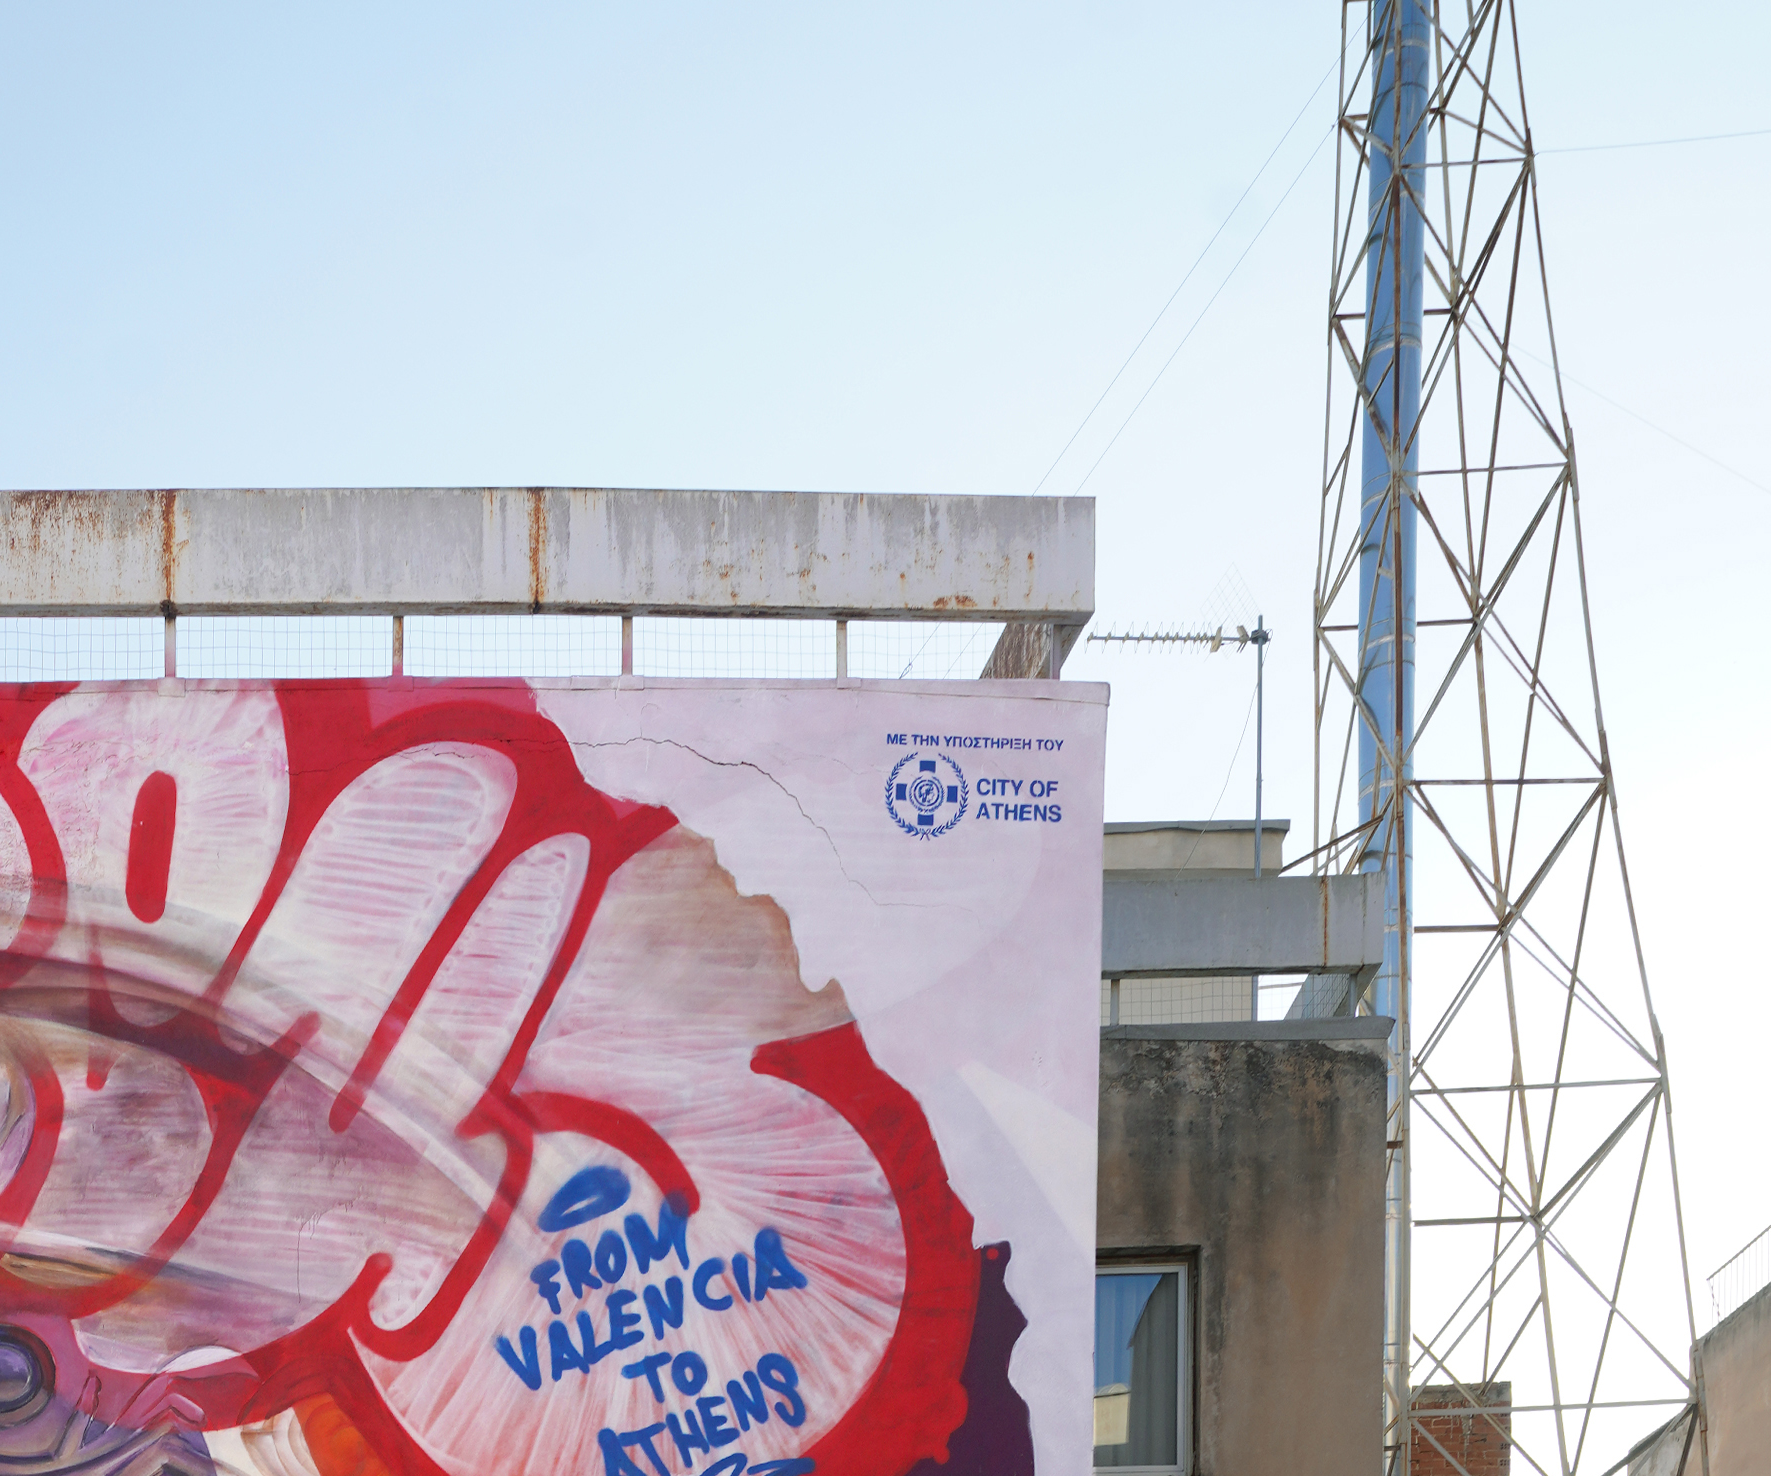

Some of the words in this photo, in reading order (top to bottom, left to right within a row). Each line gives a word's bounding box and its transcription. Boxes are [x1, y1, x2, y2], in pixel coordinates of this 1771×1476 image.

[886, 734, 908, 746] ΜΕ
[911, 734, 939, 747] ΤΗΝ
[943, 736, 1032, 751] ΥΠΟΣΤΗΡΙΞΗ
[1036, 739, 1064, 751] ΤΟΥ
[976, 778, 1024, 797] CITY
[1029, 780, 1059, 798] OF
[976, 802, 1062, 823] ATHENS
[530, 1193, 691, 1315] FROM
[494, 1226, 809, 1391] VALENCIA
[622, 1350, 709, 1404] TO
